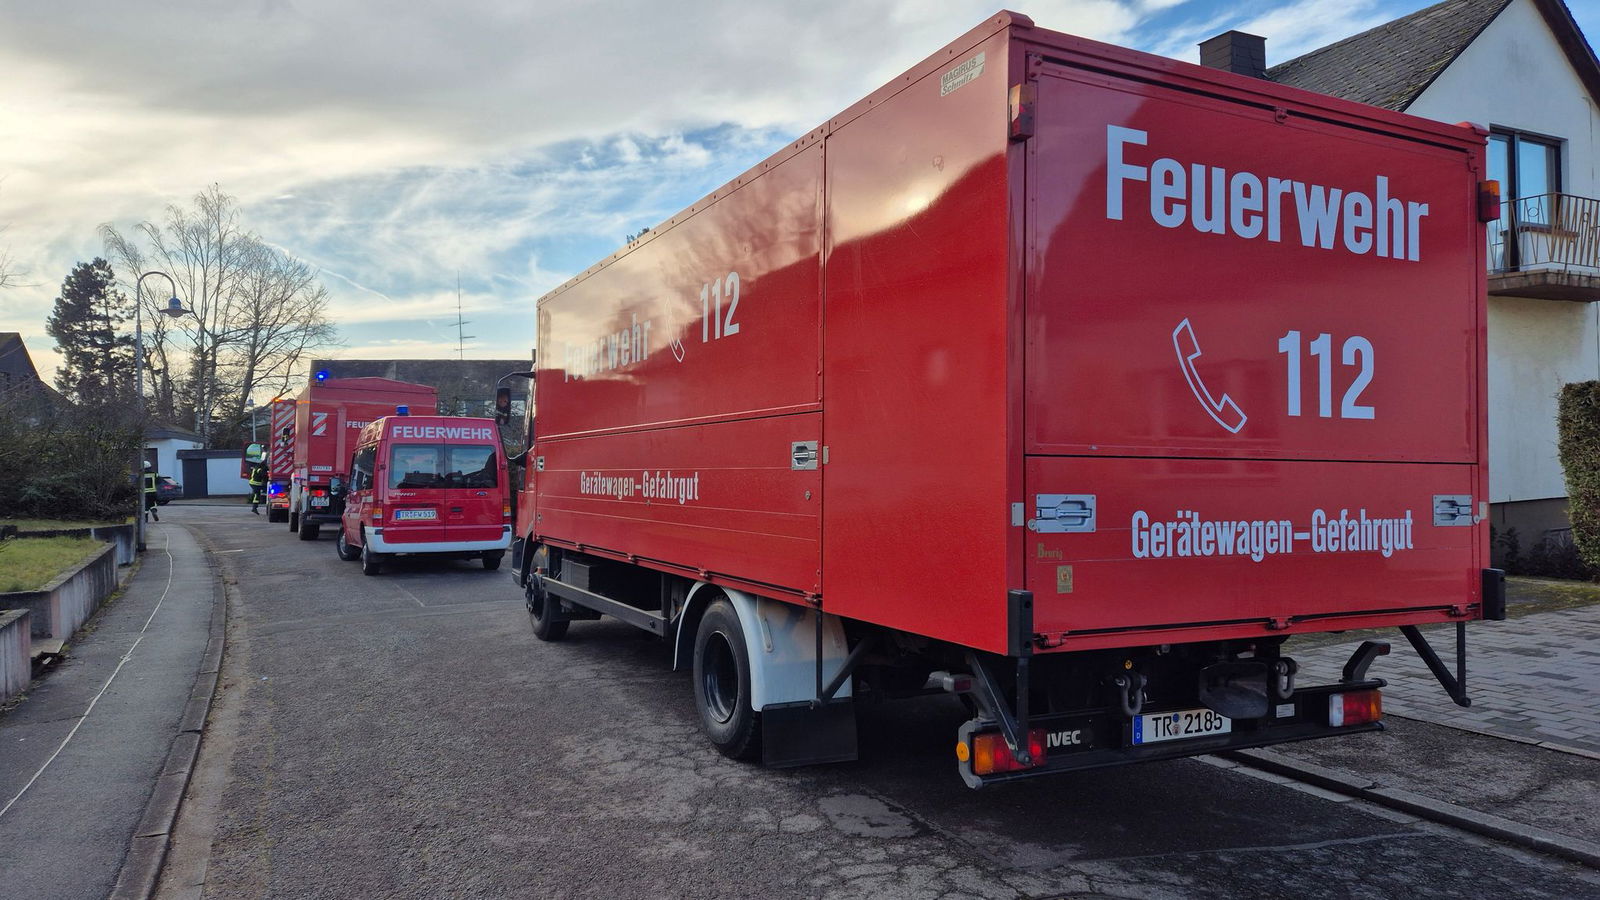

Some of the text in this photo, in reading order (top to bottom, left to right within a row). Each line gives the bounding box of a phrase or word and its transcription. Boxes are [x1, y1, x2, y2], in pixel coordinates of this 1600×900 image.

[942, 58, 977, 85] MAGIRUS
[1106, 124, 1429, 262] Feuerwehr
[700, 271, 740, 343] 112
[1278, 330, 1375, 419] 112
[392, 426, 492, 440] FEUERWEHR
[1131, 508, 1414, 563] Gerätewagen-Gefahrgut
[1152, 717, 1172, 738] TR
[1184, 711, 1223, 734] 2185
